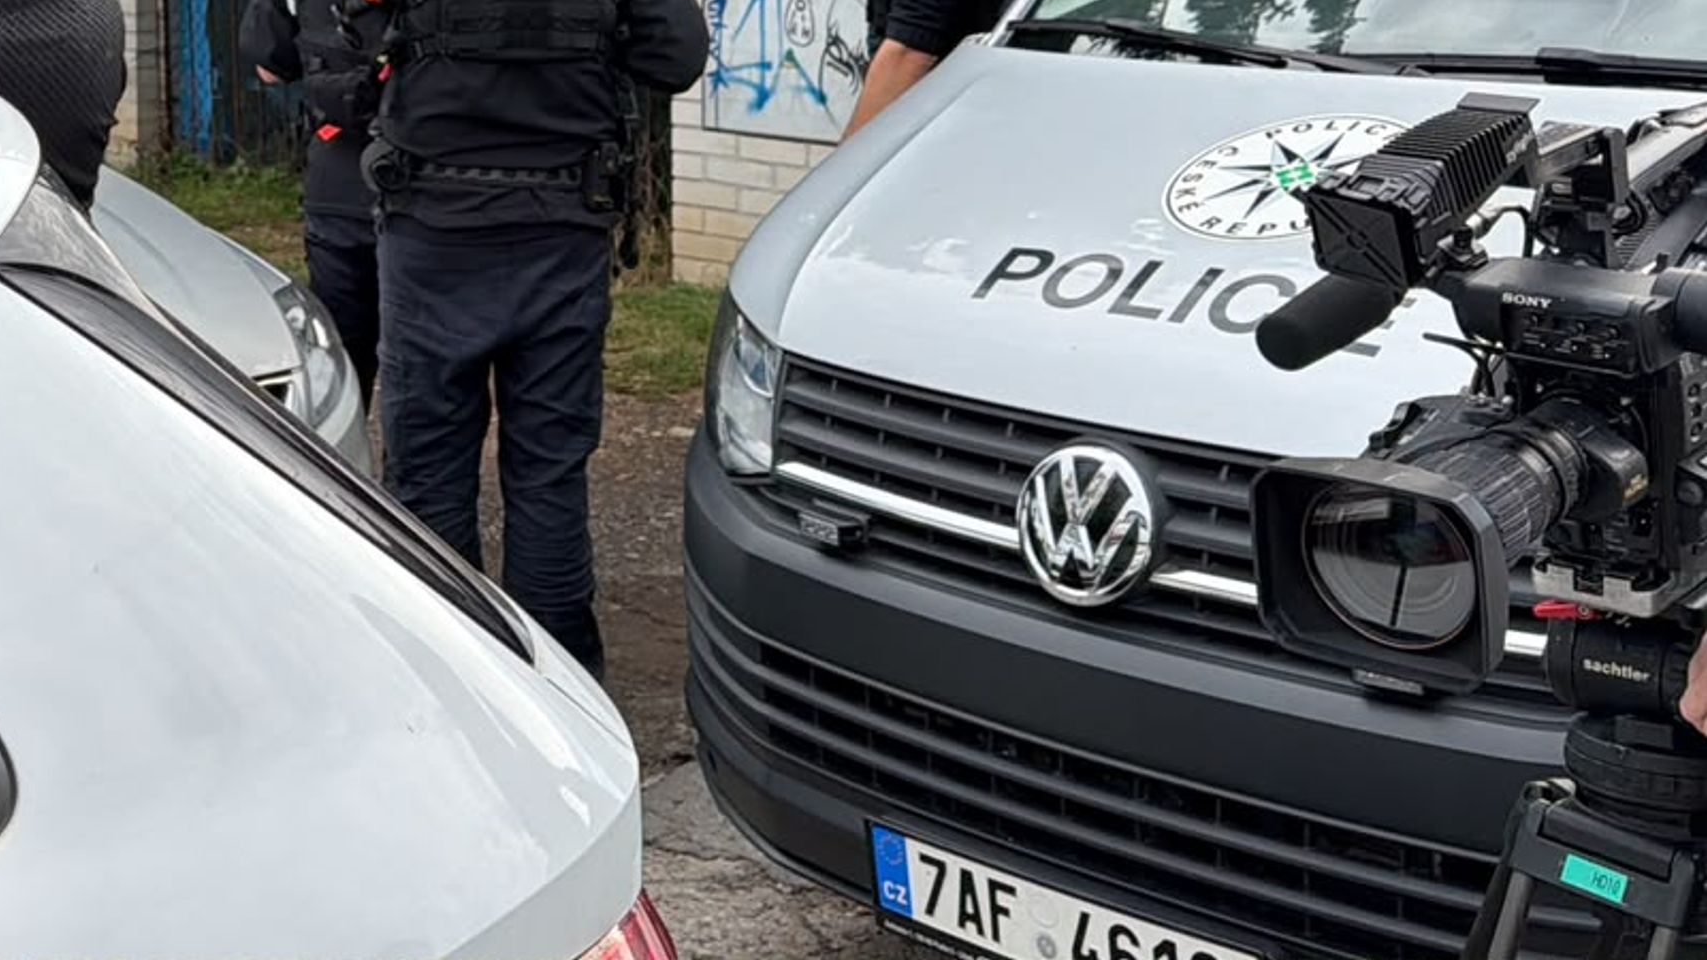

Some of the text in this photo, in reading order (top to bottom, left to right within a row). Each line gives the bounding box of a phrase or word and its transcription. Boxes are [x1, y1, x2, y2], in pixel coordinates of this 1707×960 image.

[971, 246, 1415, 358] POLIC
[1501, 291, 1552, 309] SONY
[1583, 659, 1651, 682] sachtler
[883, 880, 909, 906] CZ
[918, 852, 1018, 944] 7AF
